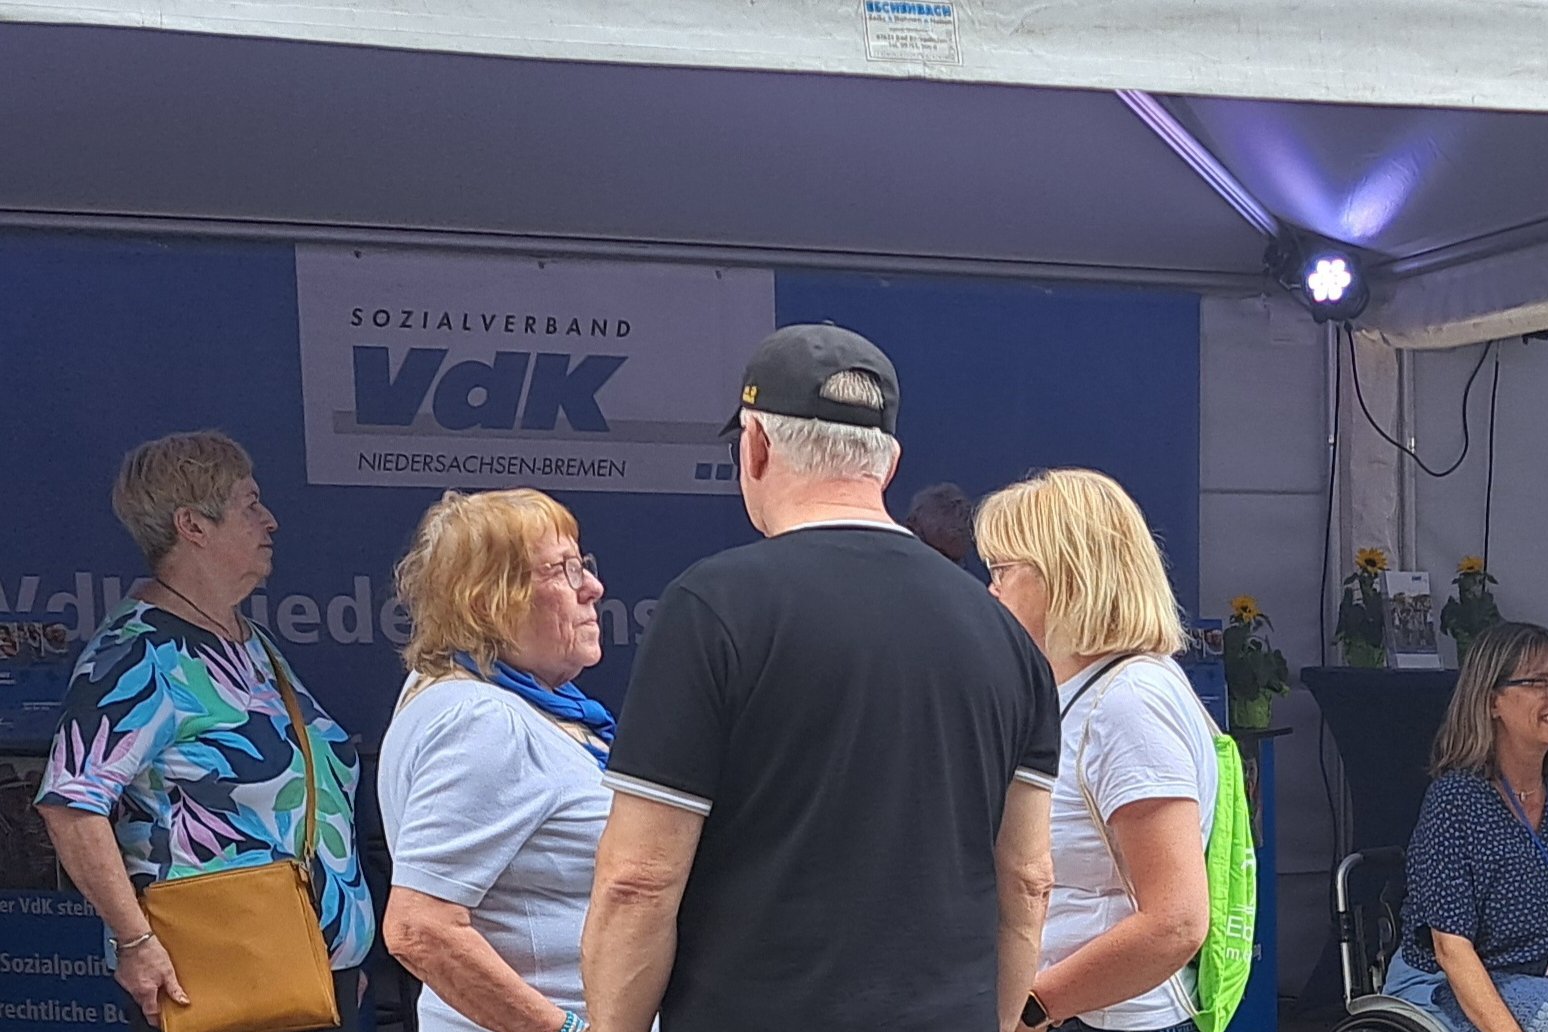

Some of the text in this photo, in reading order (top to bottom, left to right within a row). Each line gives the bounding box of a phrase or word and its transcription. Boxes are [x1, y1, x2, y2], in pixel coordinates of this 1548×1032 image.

[351, 307, 633, 338] SOZIALVERBAND
[352, 345, 630, 433] VdK
[357, 452, 627, 478] NIEDERSACHSEN-BREMEN
[19, 898, 52, 915] VdK
[0, 952, 115, 979] Sozialpolit
